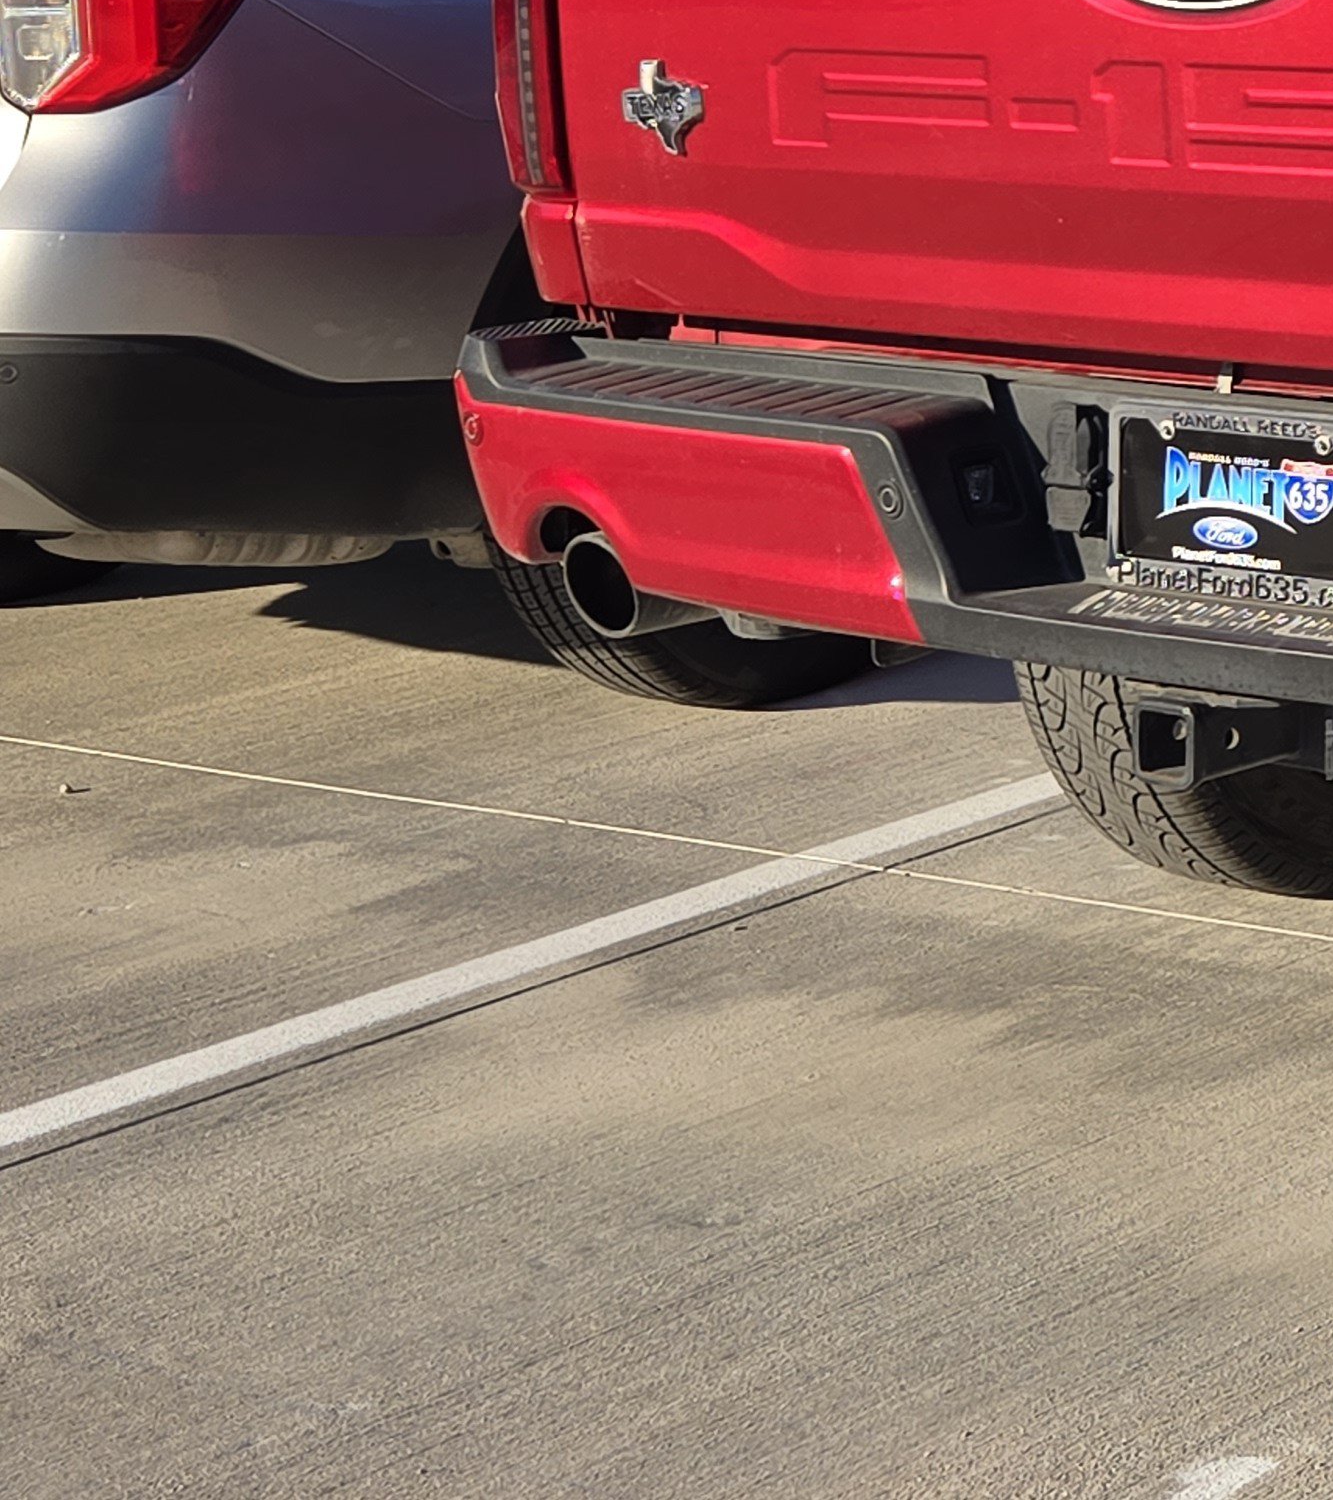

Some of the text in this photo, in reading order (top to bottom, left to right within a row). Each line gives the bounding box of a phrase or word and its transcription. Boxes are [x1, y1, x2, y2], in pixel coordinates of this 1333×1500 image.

[1172, 411, 1250, 434] RANDALL
[1164, 446, 1329, 521] PLANET 635
[1204, 519, 1246, 546] Ford
